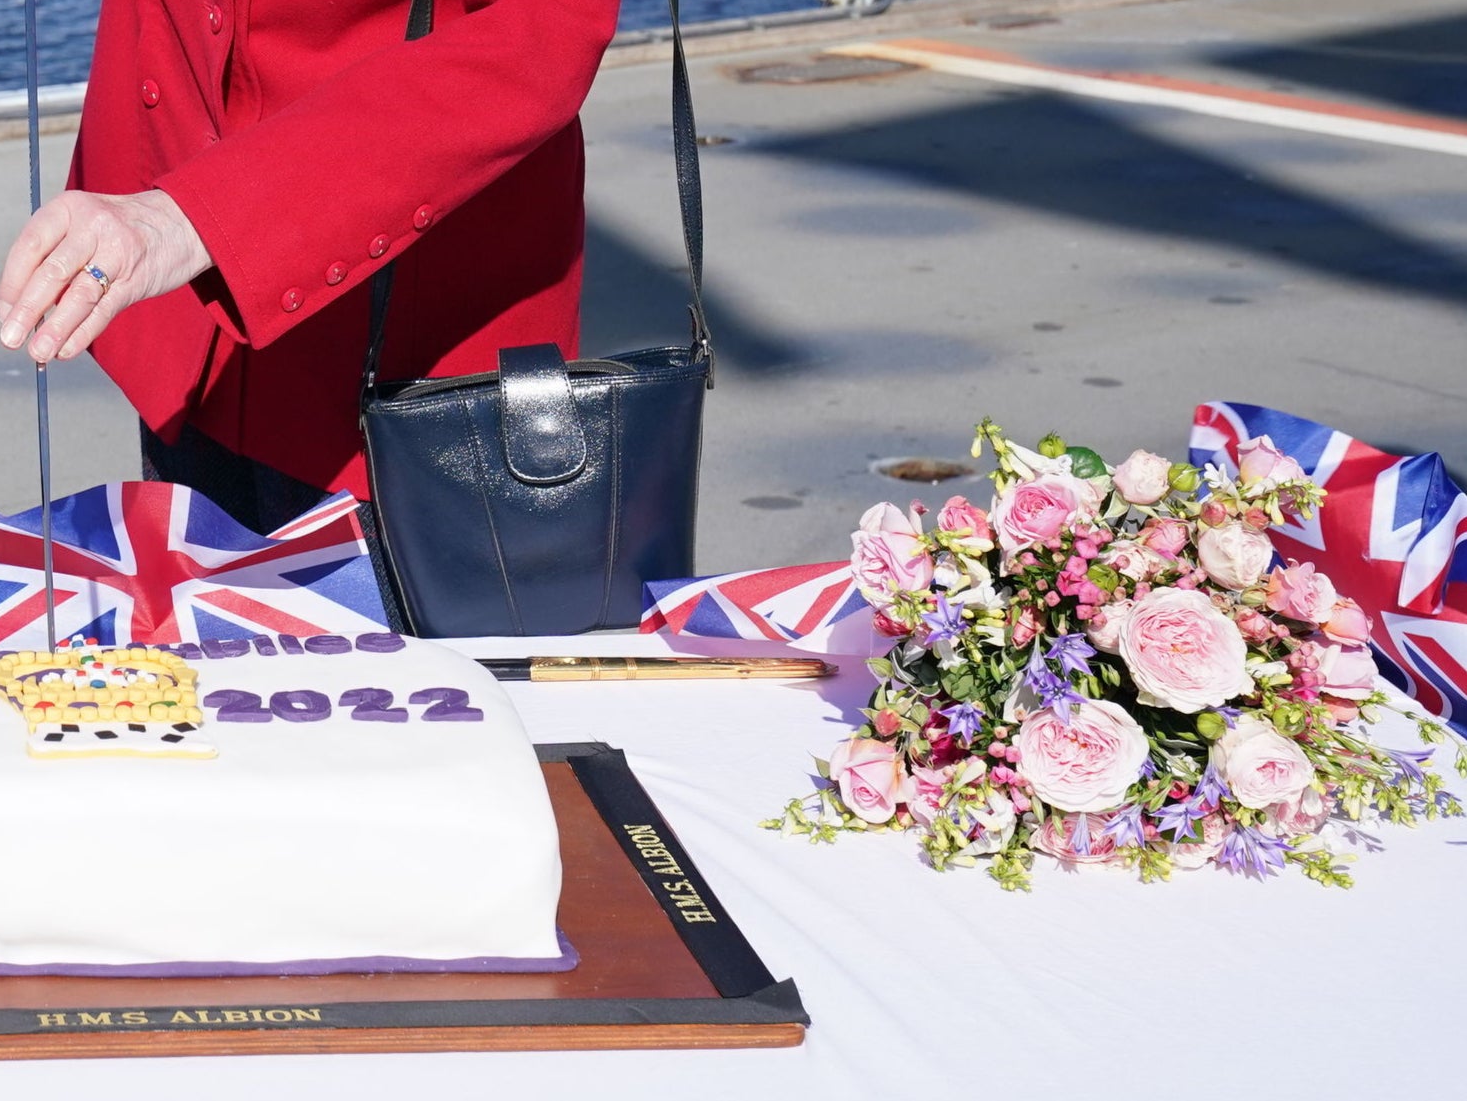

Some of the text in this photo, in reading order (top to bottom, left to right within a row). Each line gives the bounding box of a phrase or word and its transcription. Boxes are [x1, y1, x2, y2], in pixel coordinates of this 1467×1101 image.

[101, 632, 407, 660] ubilee
[203, 687, 485, 723] 2022
[623, 824, 685, 876] ALBION
[169, 1008, 322, 1024] ALBION
